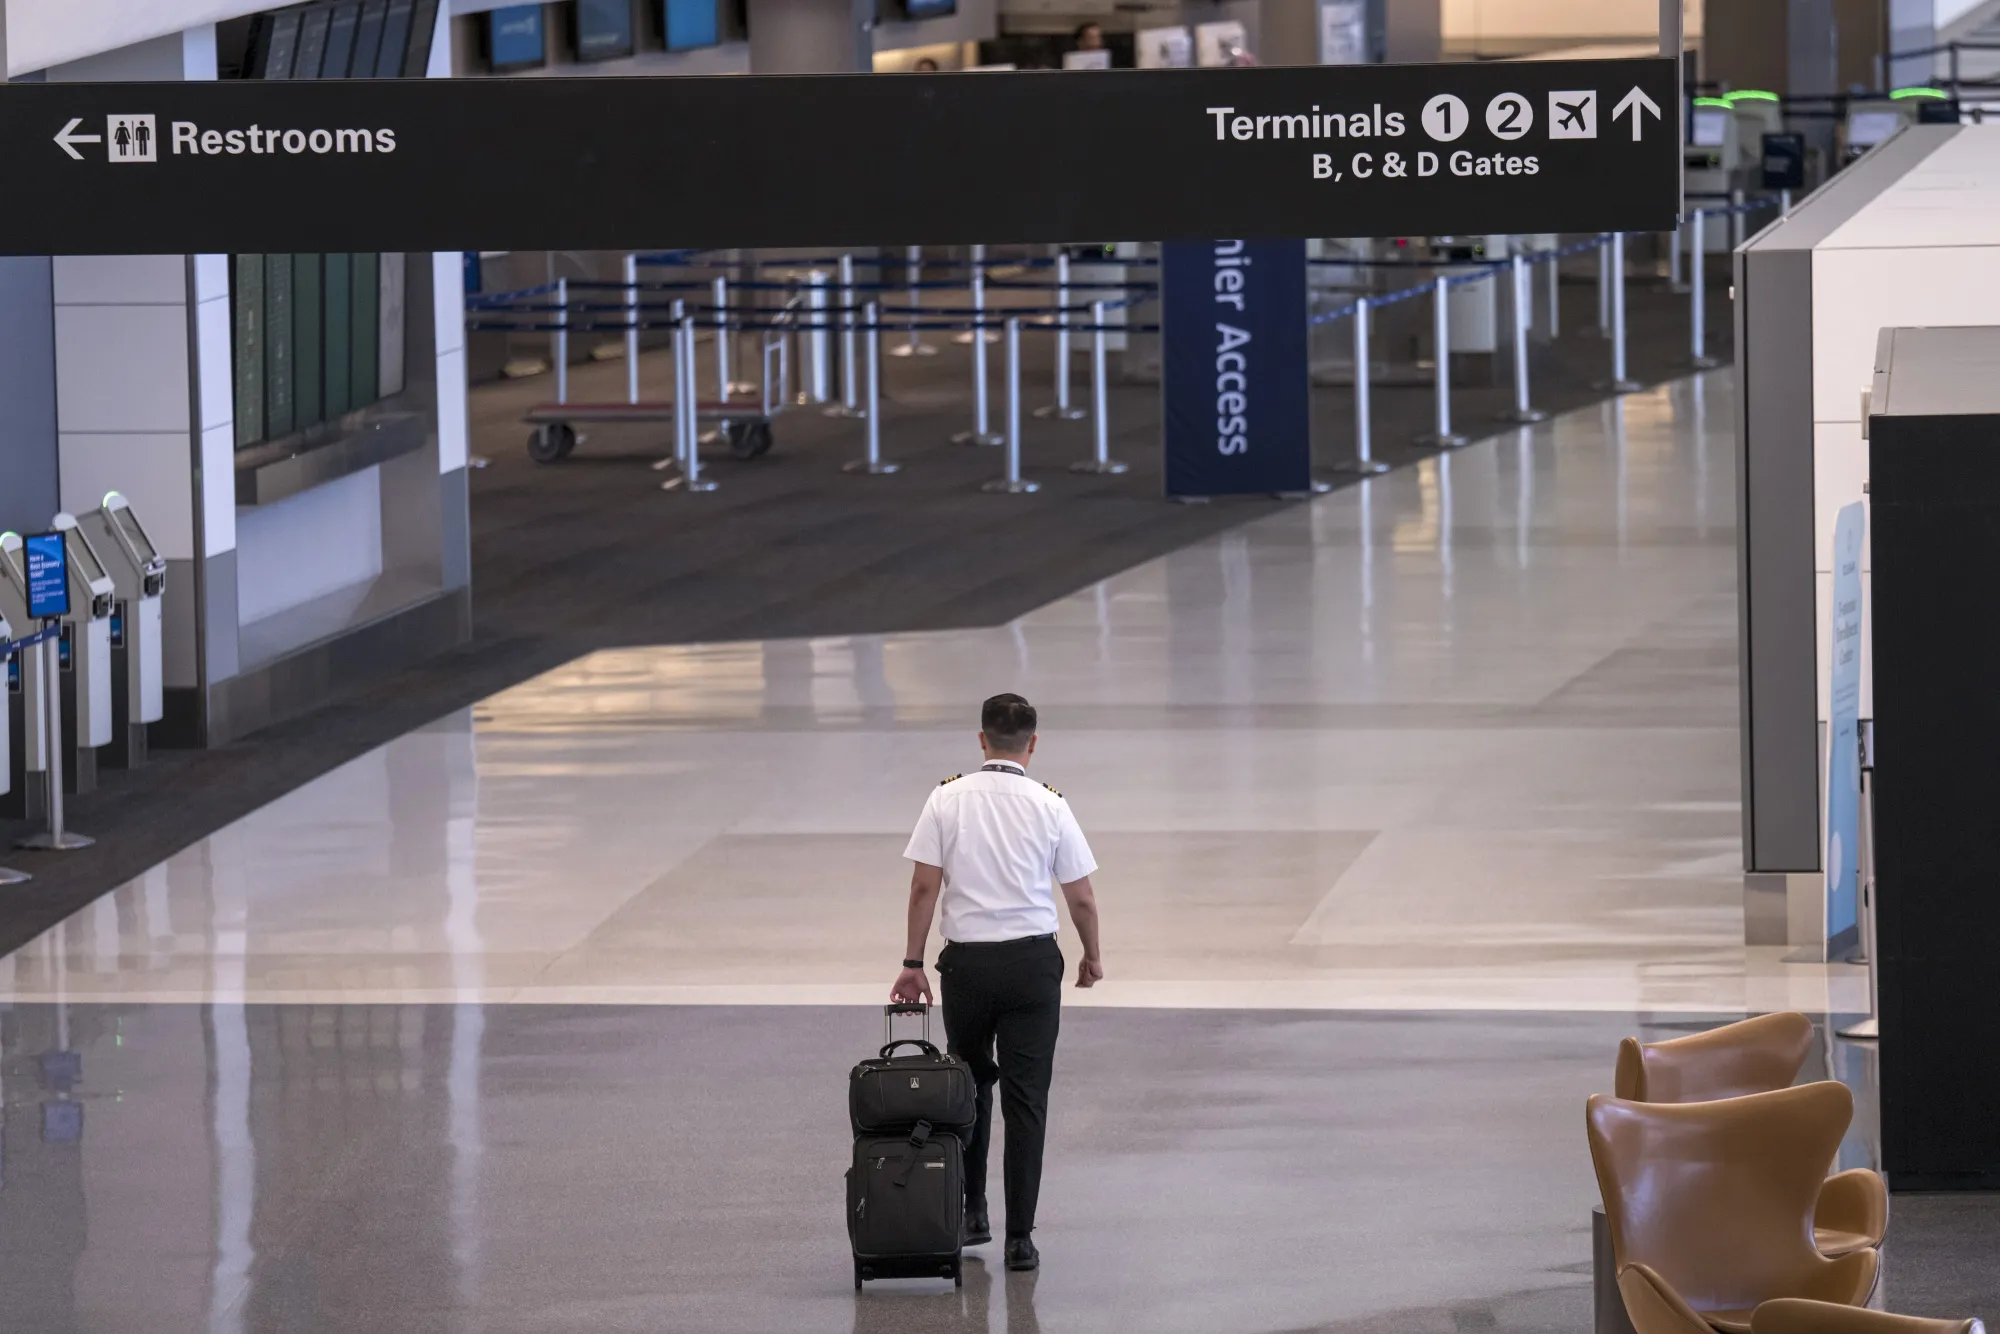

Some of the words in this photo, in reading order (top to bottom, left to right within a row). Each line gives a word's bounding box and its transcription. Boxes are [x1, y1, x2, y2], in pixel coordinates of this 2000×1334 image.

[171, 121, 396, 155] Restrooms
[1206, 103, 1406, 141] Terminals
[1435, 102, 1453, 135] 1
[1496, 99, 1523, 134] 2
[1313, 153, 1343, 182] B,
[1351, 152, 1374, 178] C
[1381, 152, 1408, 178] &
[1417, 151, 1439, 177] D
[1449, 150, 1541, 177] Gates
[1215, 323, 1252, 456] Access
